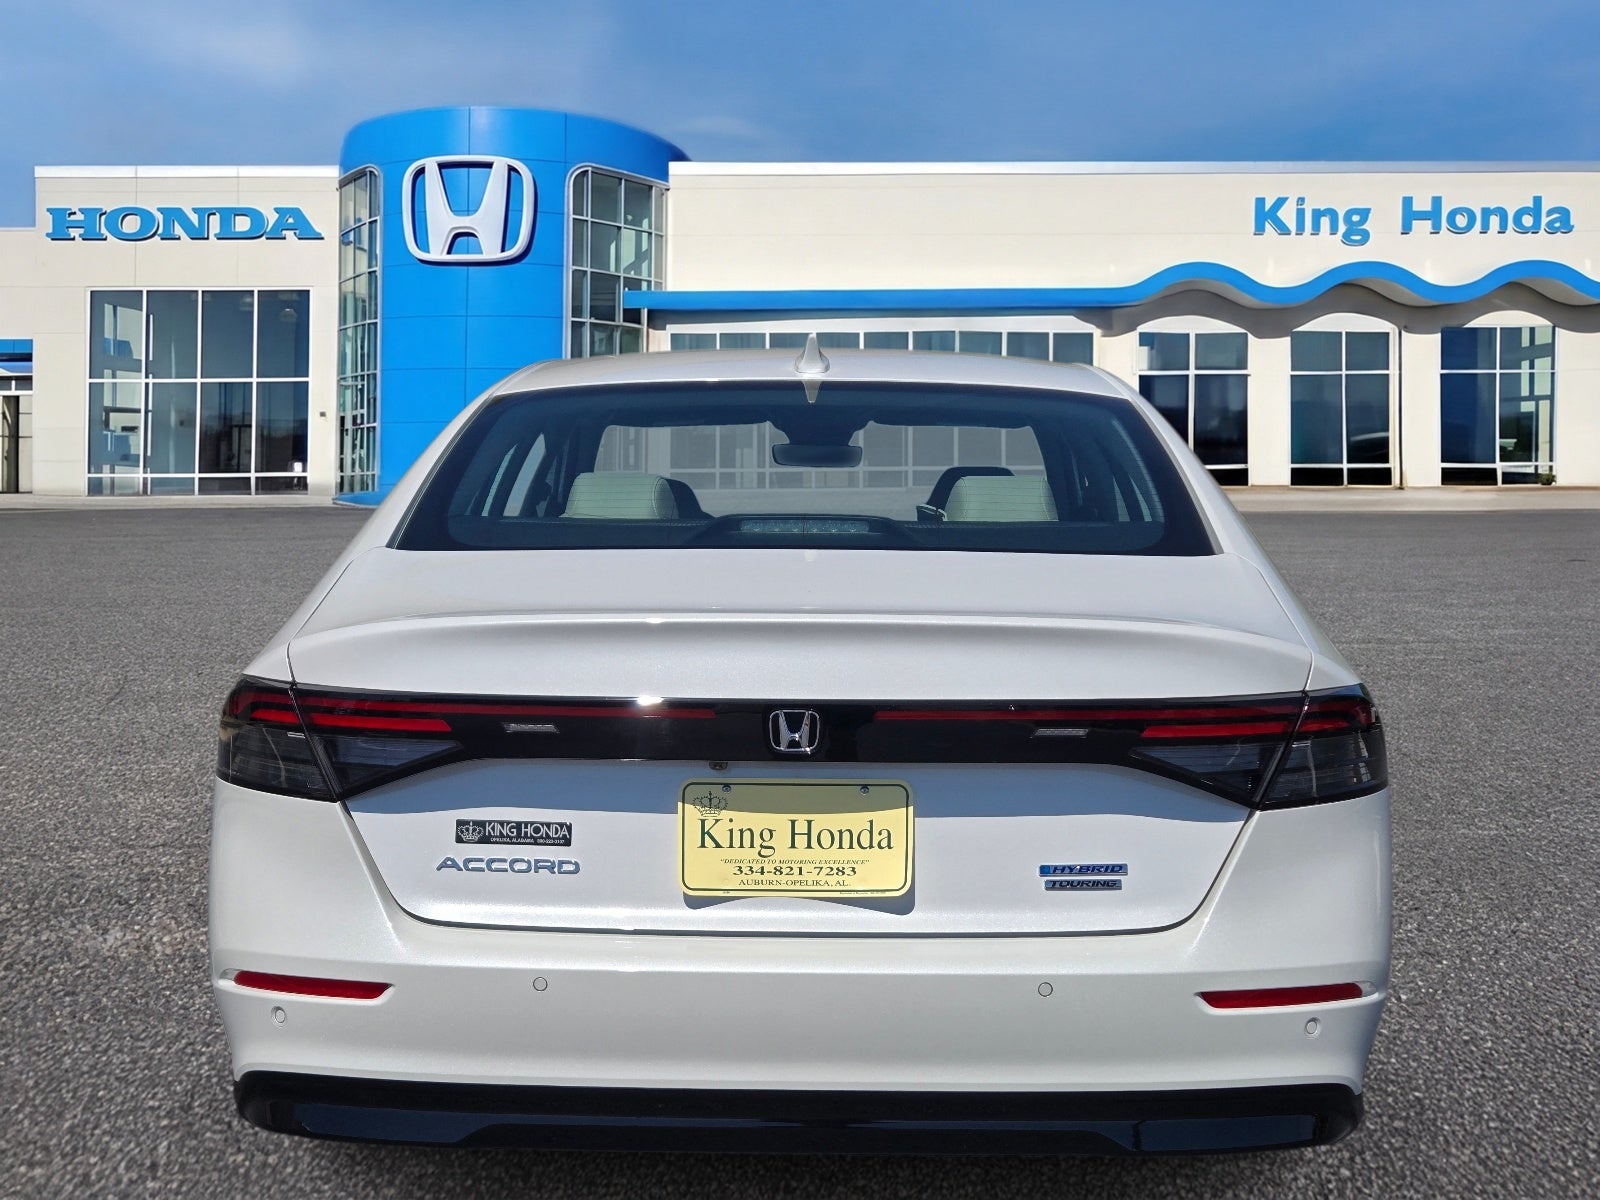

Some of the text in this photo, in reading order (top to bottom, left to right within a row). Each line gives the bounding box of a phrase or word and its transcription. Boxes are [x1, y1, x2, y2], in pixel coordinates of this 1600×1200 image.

[46, 206, 324, 241] HONDA
[1253, 195, 1574, 246] King Honda
[485, 822, 569, 838] KING HONDA
[697, 818, 894, 858] King Honda
[436, 856, 580, 874] ACCORD
[732, 865, 857, 876] 334-821-7283
[1052, 865, 1123, 874] HYBRID
[738, 879, 833, 887] AUBURN-OPELIKA,
[1050, 880, 1117, 888] TOURING
